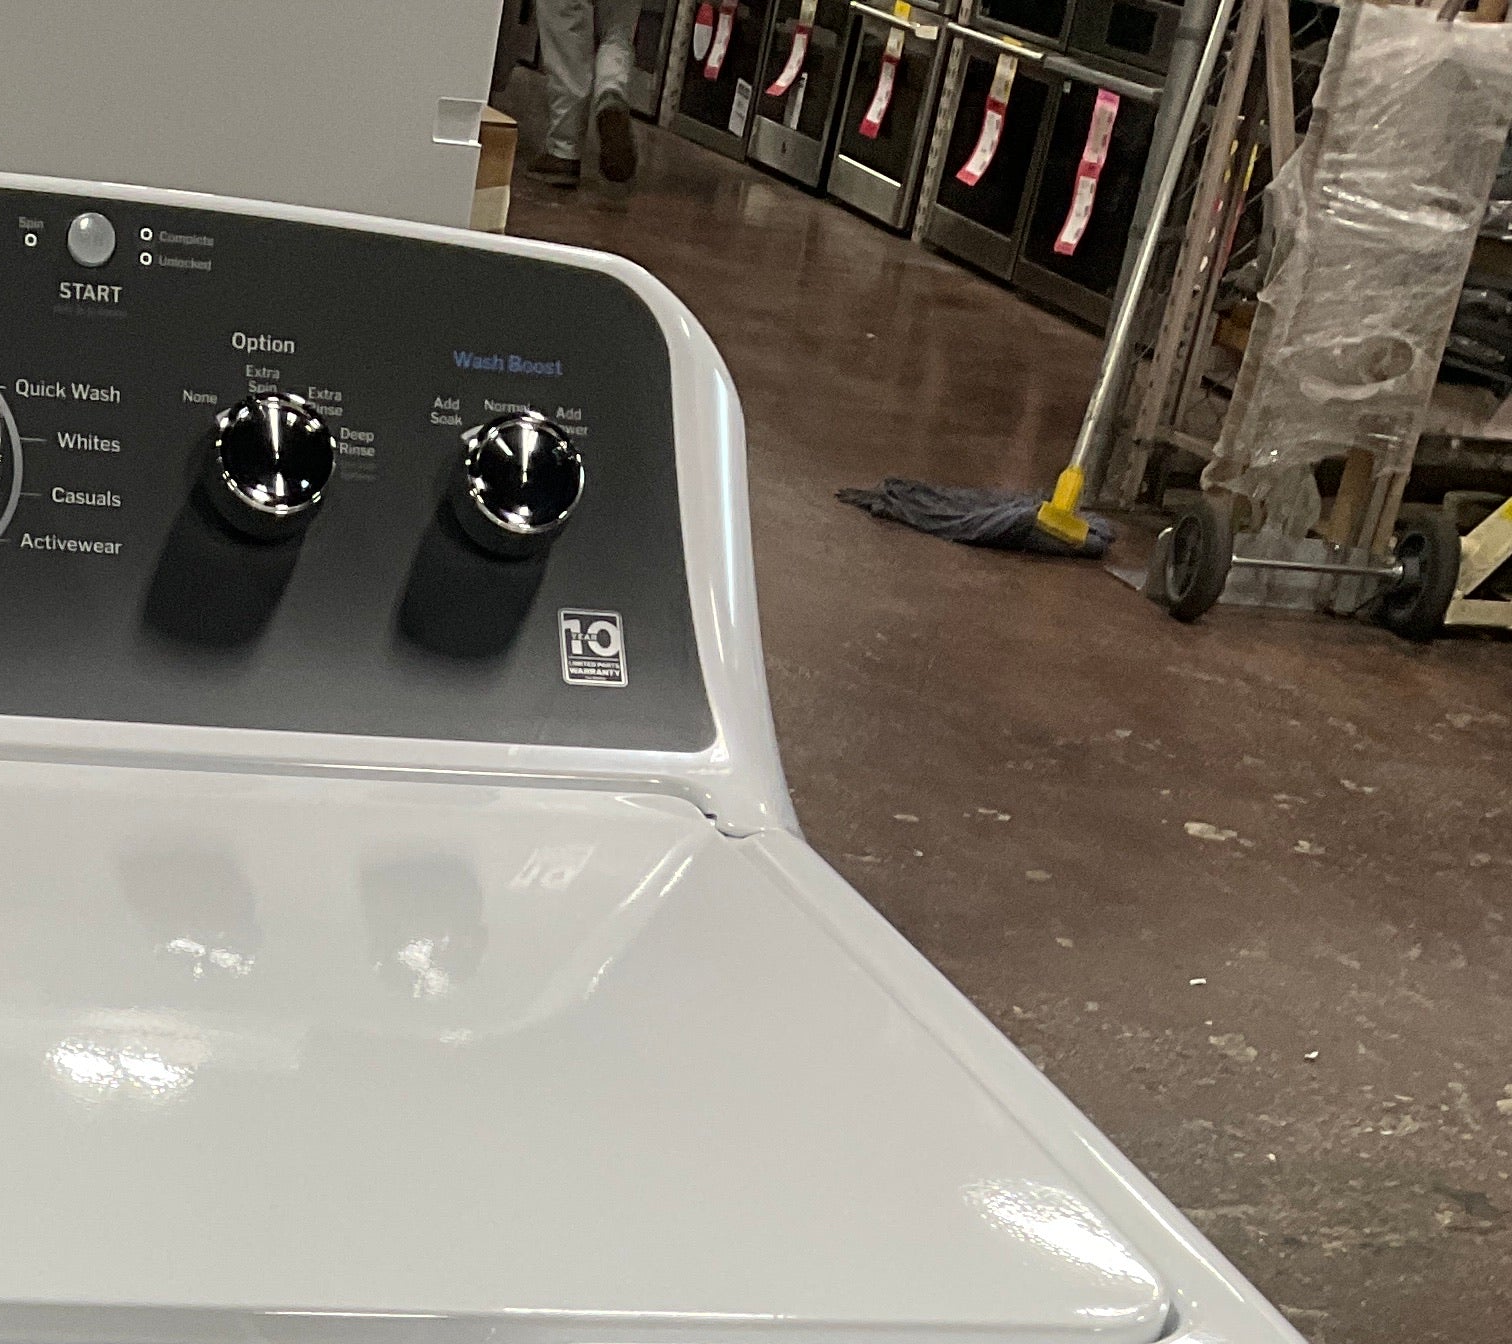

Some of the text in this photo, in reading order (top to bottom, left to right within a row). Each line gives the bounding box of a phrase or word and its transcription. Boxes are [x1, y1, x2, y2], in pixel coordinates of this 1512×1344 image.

[18, 216, 45, 230] Spin
[59, 281, 123, 304] START
[231, 331, 296, 354] Option
[453, 350, 563, 376] Wash Boost
[245, 364, 281, 380] Extra
[15, 378, 122, 404] Quick Wash
[248, 380, 279, 395] Spin
[308, 386, 343, 402] Extra
[182, 389, 219, 406] None
[433, 396, 461, 411] Add
[430, 411, 463, 426] Soak
[555, 406, 583, 421] Add
[57, 431, 122, 453] Whites
[340, 426, 375, 443] Deep
[339, 442, 376, 457] Rinse
[51, 486, 122, 508] Casuals
[20, 532, 123, 555] Activewear
[562, 618, 622, 658] 10
